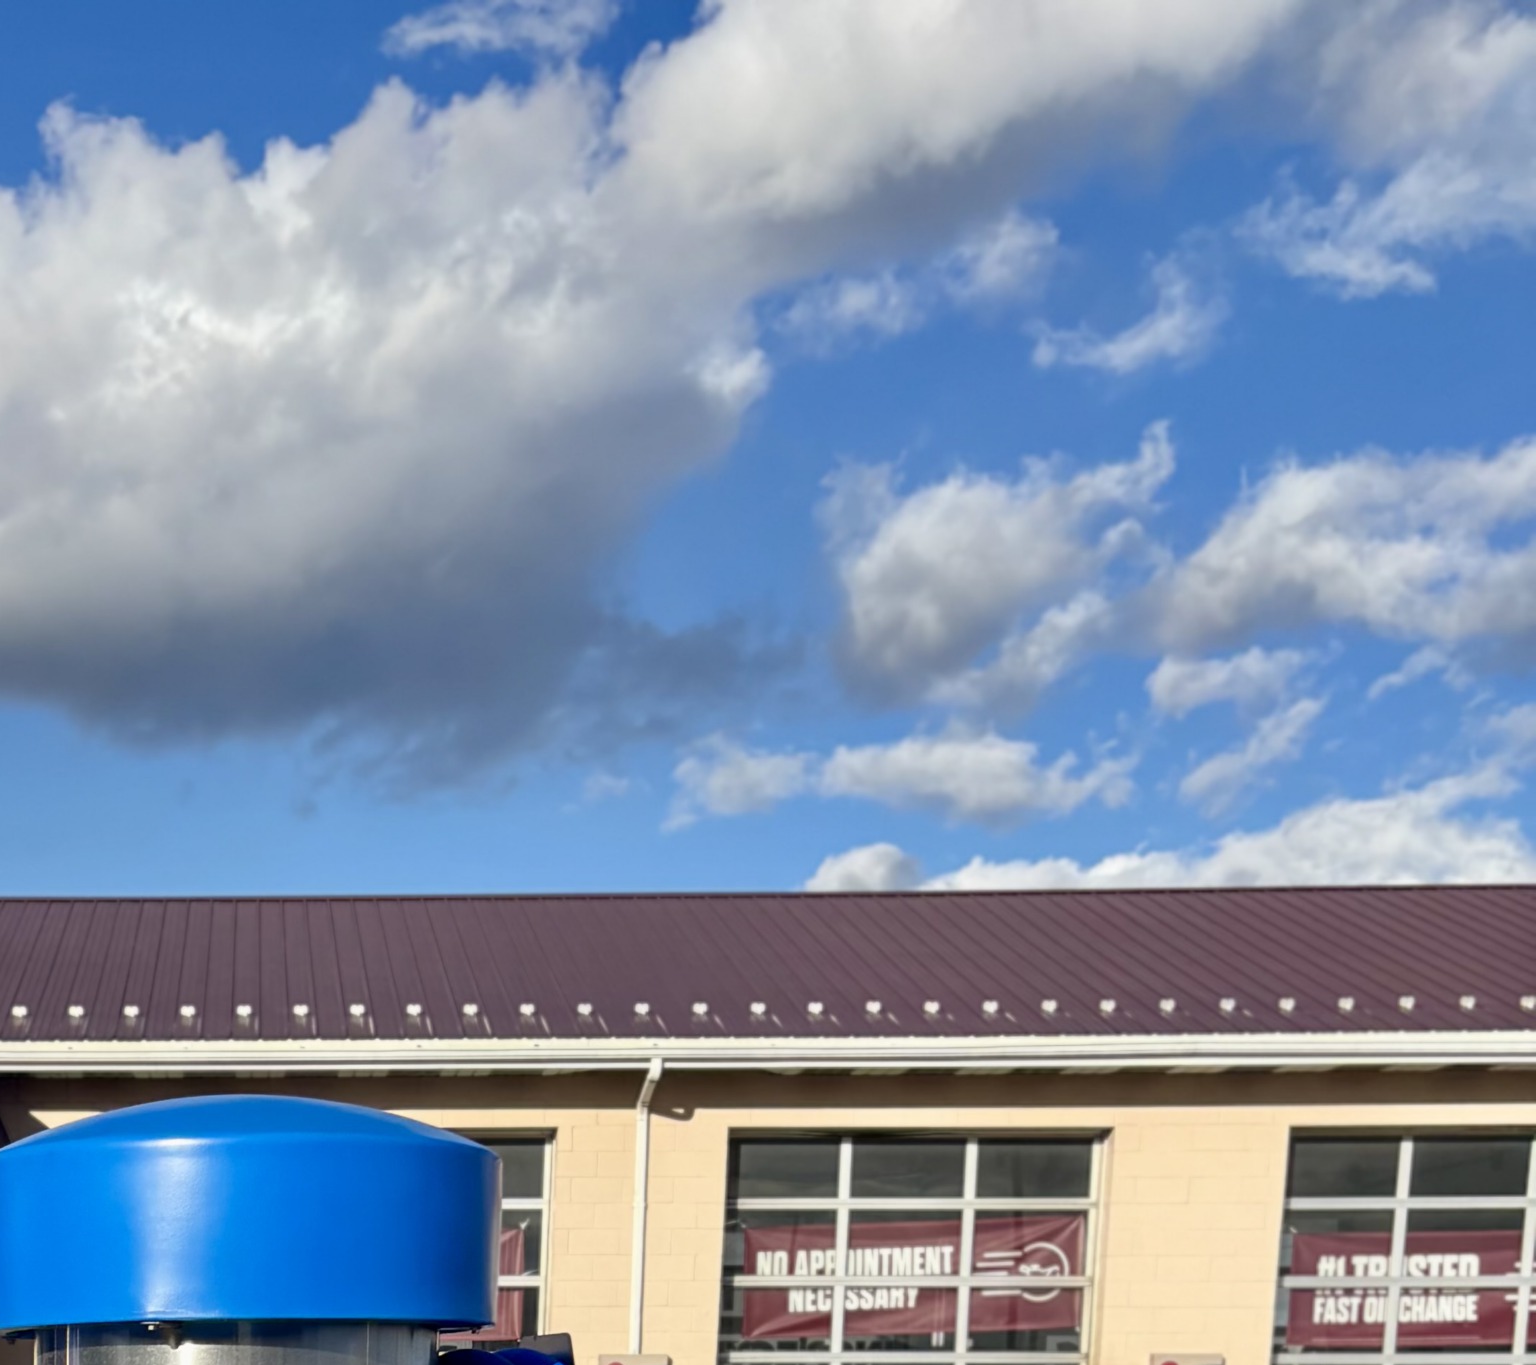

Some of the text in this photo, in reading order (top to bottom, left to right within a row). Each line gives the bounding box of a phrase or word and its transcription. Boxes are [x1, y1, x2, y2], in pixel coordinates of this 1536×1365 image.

[756, 1251, 789, 1277] NO
[1351, 1253, 1480, 1295] TRSTED
[788, 1287, 920, 1313] NECSSARY
[1313, 1295, 1480, 1324] FAST OI CHANGE
